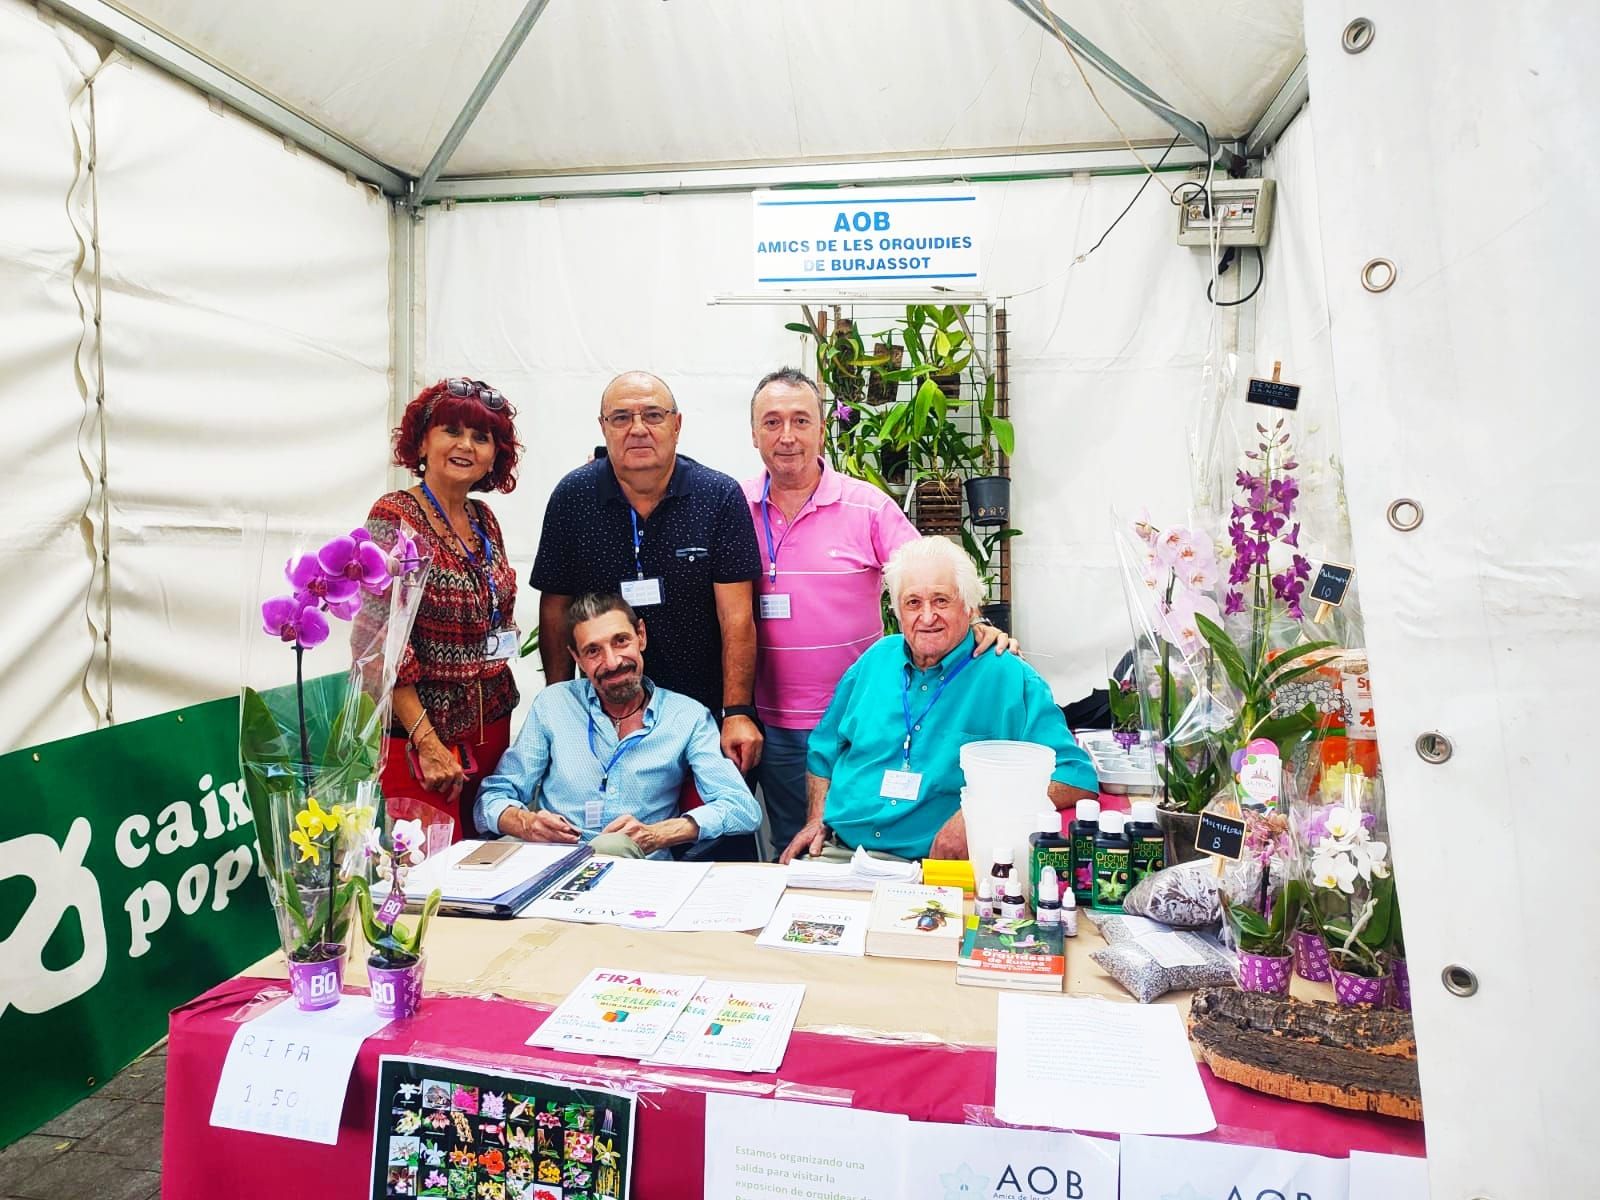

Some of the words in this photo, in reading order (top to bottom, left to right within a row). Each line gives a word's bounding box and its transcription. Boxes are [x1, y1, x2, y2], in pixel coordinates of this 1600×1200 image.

[834, 211, 891, 233] AOB
[757, 240, 810, 254] AMICS
[816, 239, 838, 252] DE
[843, 239, 874, 252] LES
[879, 236, 972, 252] ORQUIDIES
[803, 260, 825, 272] DE
[831, 257, 931, 271] BURJASSOT
[115, 774, 254, 868] caix
[1131, 841, 1164, 850] Orchid
[1212, 837, 1221, 849] 8
[1037, 852, 1069, 861] Orchid
[1095, 852, 1128, 861] Orchid
[1134, 849, 1163, 858] Focus
[1096, 860, 1128, 869] Focus
[384, 900, 401, 915] BO
[1006, 957, 1046, 966] Europa
[311, 972, 337, 997] BO
[595, 973, 642, 985] FIRA
[373, 981, 396, 1004] BO
[240, 1034, 311, 1062] RIFA
[735, 1146, 777, 1160] Estamos
[780, 1152, 843, 1168] organizando
[845, 1161, 865, 1170] una
[735, 1163, 764, 1175] salida
[767, 1168, 790, 1178] para
[792, 1170, 824, 1184] visitar
[826, 1174, 836, 1184] la
[735, 1180, 788, 1195] exposicion
[790, 1186, 804, 1196] de
[996, 1164, 1084, 1199] AOB
[993, 1192, 1015, 1200] Amics
